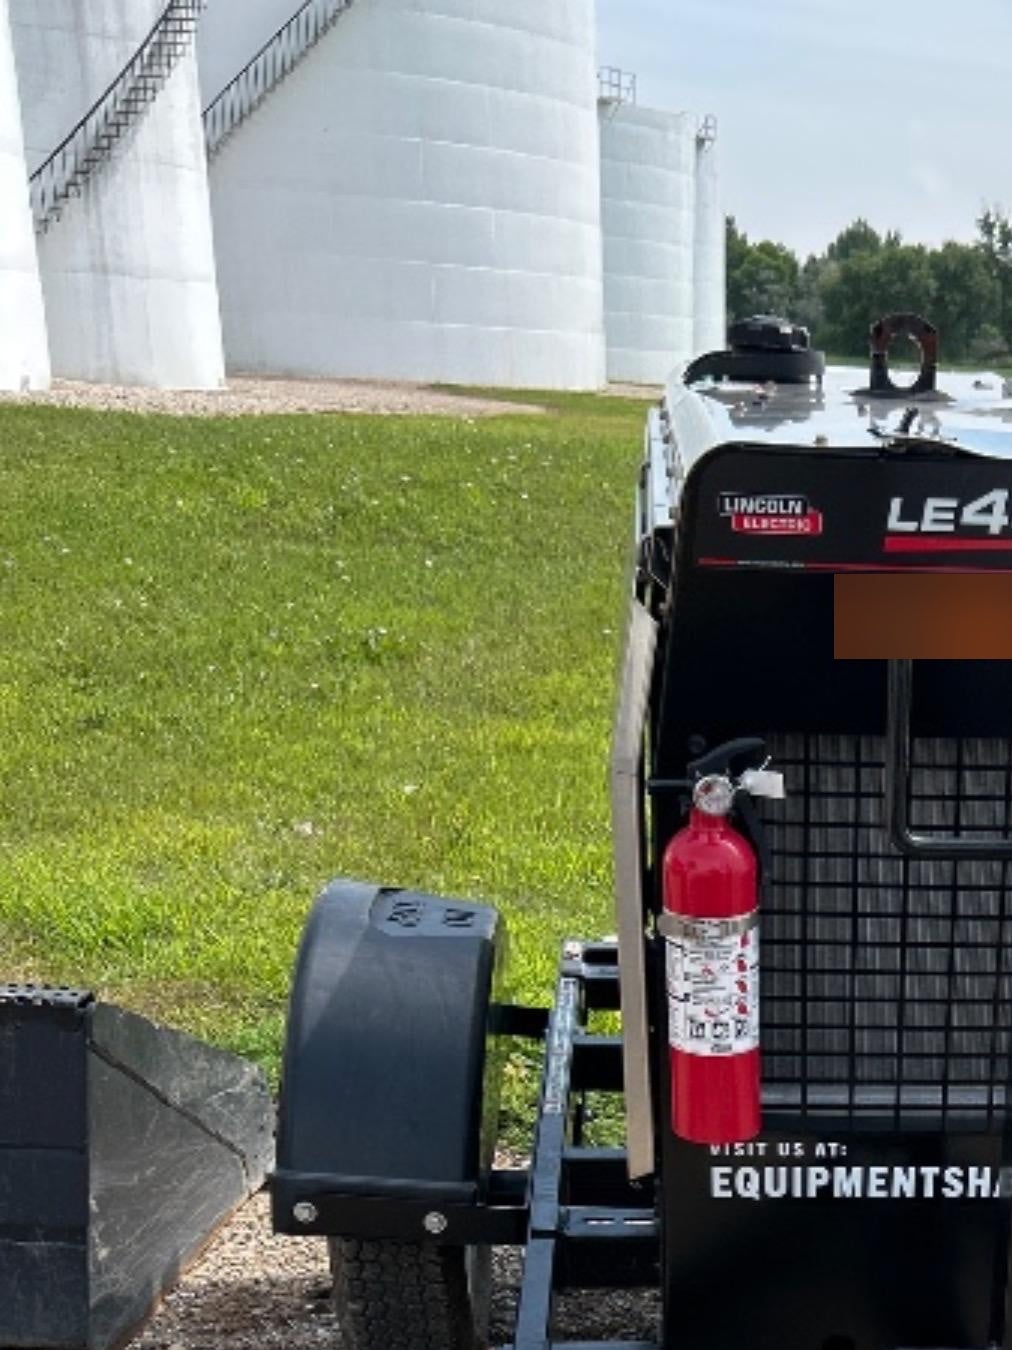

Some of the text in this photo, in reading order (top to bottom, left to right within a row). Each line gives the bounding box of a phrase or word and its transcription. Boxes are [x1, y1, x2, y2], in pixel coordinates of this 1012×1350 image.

[724, 497, 803, 514] LINCOLN
[742, 517, 811, 532] ELECTRIC
[709, 1142, 848, 1158] VISIT US AT:
